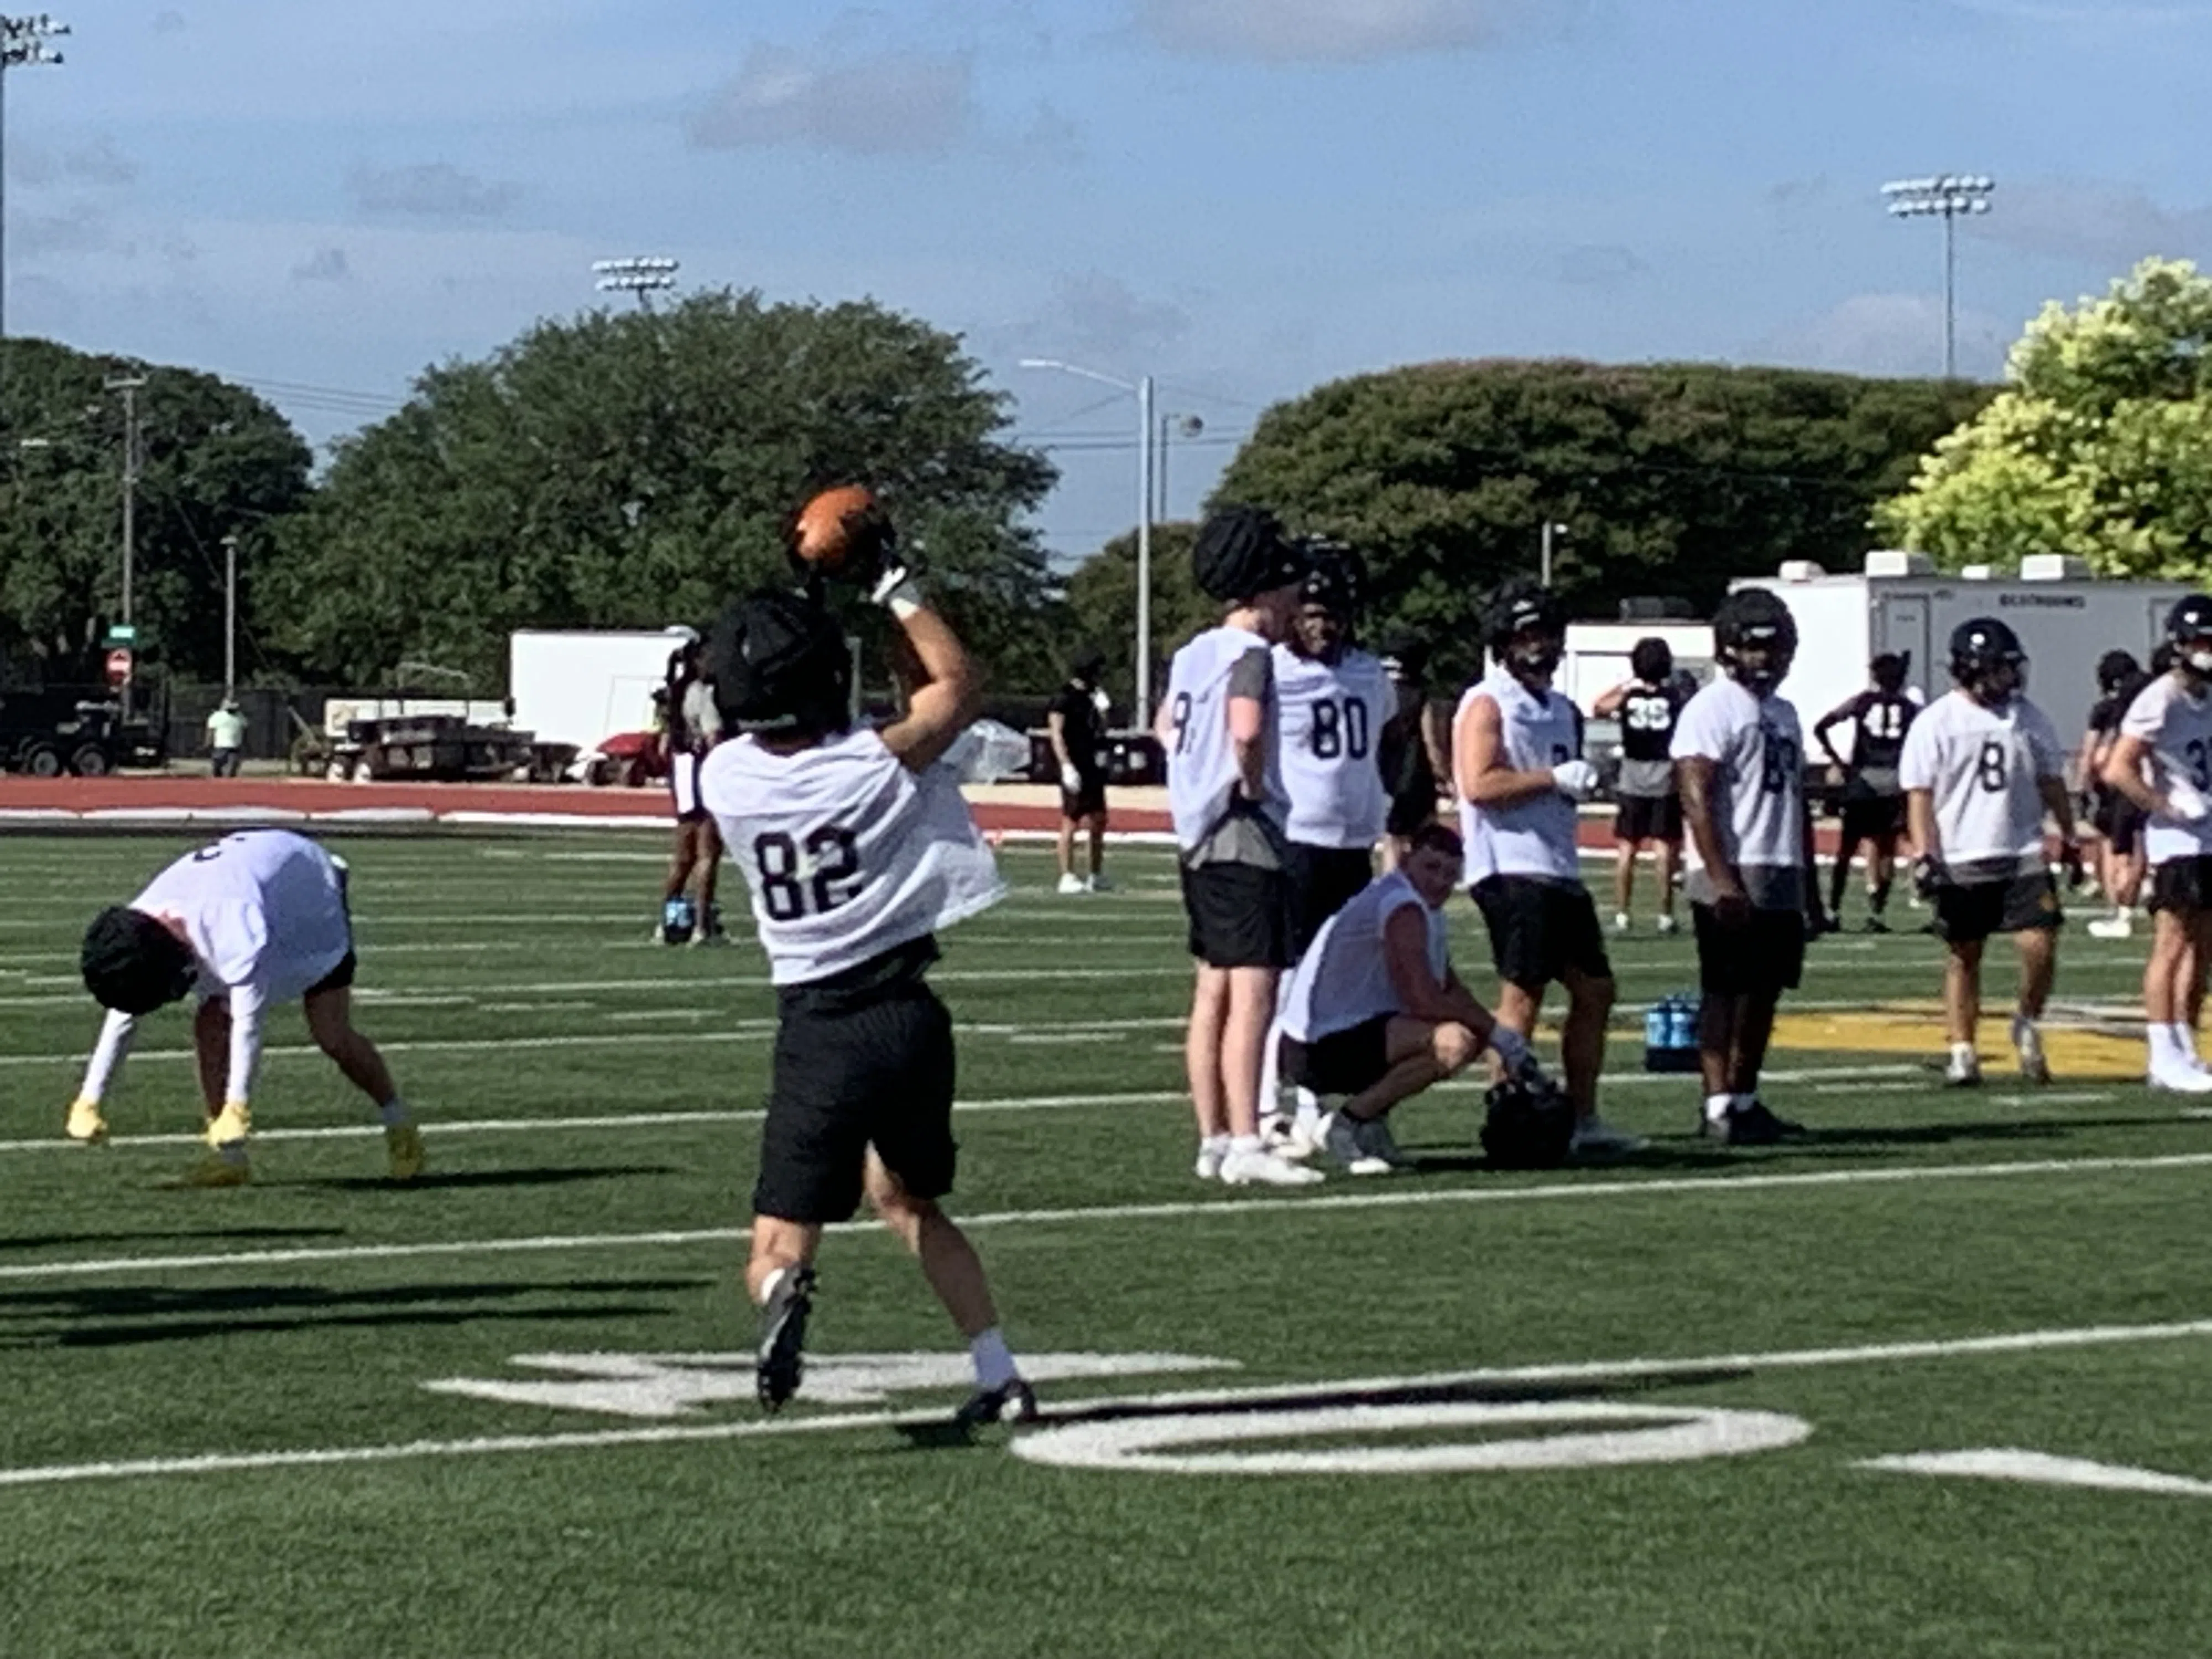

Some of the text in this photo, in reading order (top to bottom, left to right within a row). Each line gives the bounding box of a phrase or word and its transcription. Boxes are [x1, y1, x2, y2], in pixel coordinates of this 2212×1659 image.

[1312, 697, 1369, 760] 80
[1979, 741, 2005, 793] 8
[754, 826, 863, 920] 82
